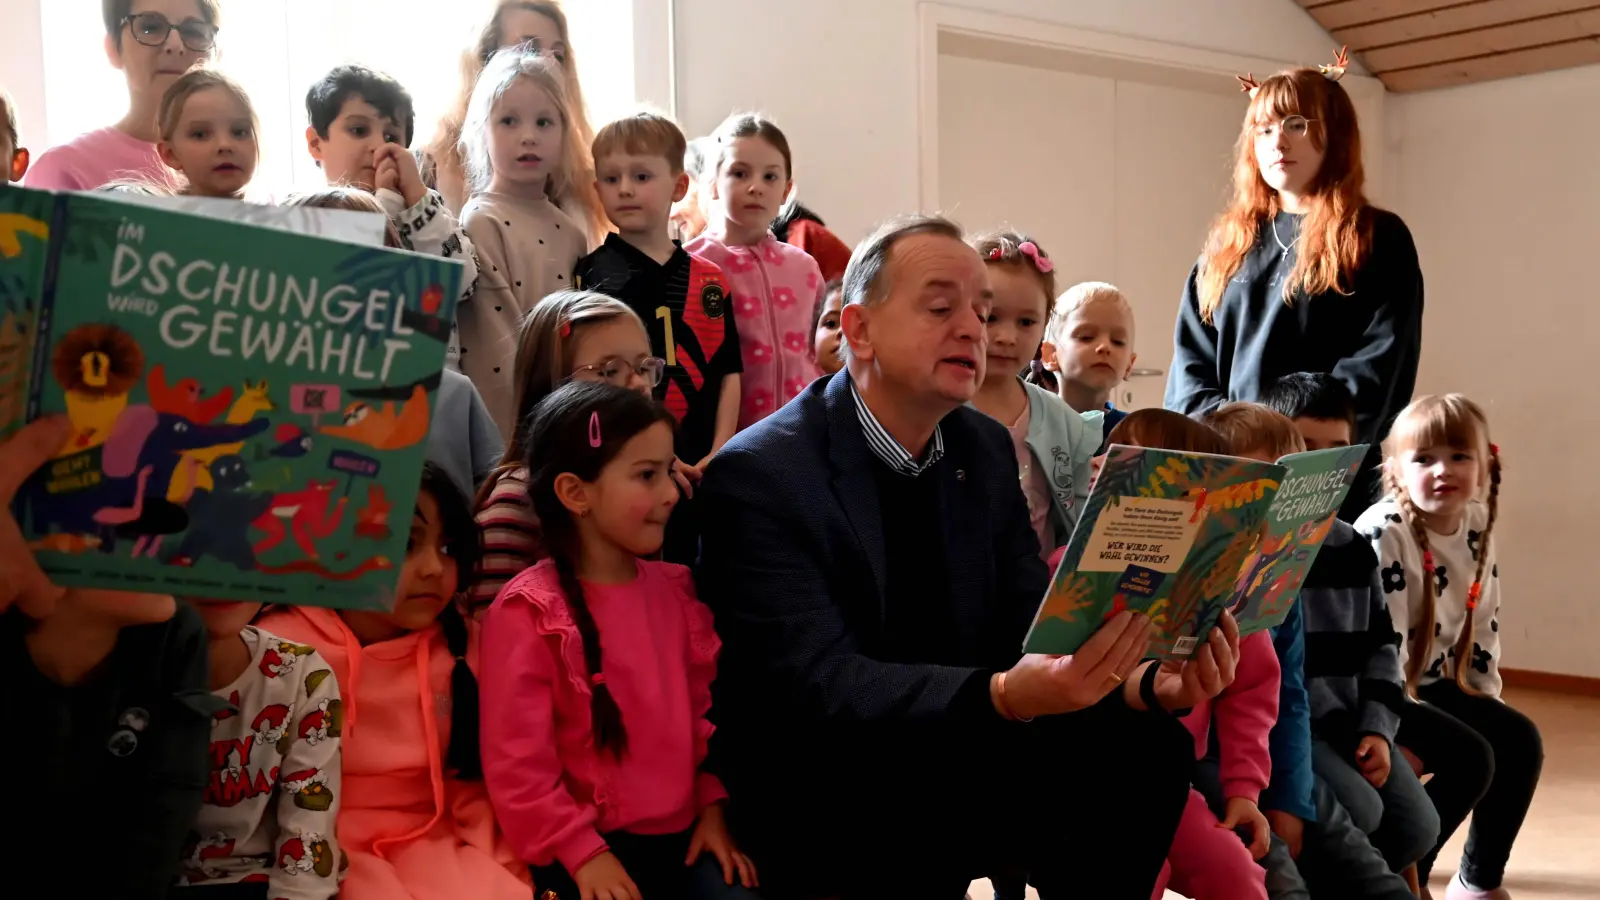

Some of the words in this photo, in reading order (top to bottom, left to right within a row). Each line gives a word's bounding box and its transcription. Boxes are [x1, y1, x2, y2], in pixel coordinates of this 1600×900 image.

[110, 243, 414, 336] DSCHUNGEL
[159, 304, 412, 382] GEWÄHLT
[655, 305, 677, 366] 1
[1275, 468, 1348, 501] DSCHUNGEL
[1276, 490, 1341, 522] GEWÄHLT
[1099, 551, 1122, 560] WAHL
[1123, 553, 1170, 564] GEWINNEN?
[1107, 541, 1125, 550] WER
[1126, 542, 1147, 552] WIRD
[1149, 544, 1163, 553] DIE
